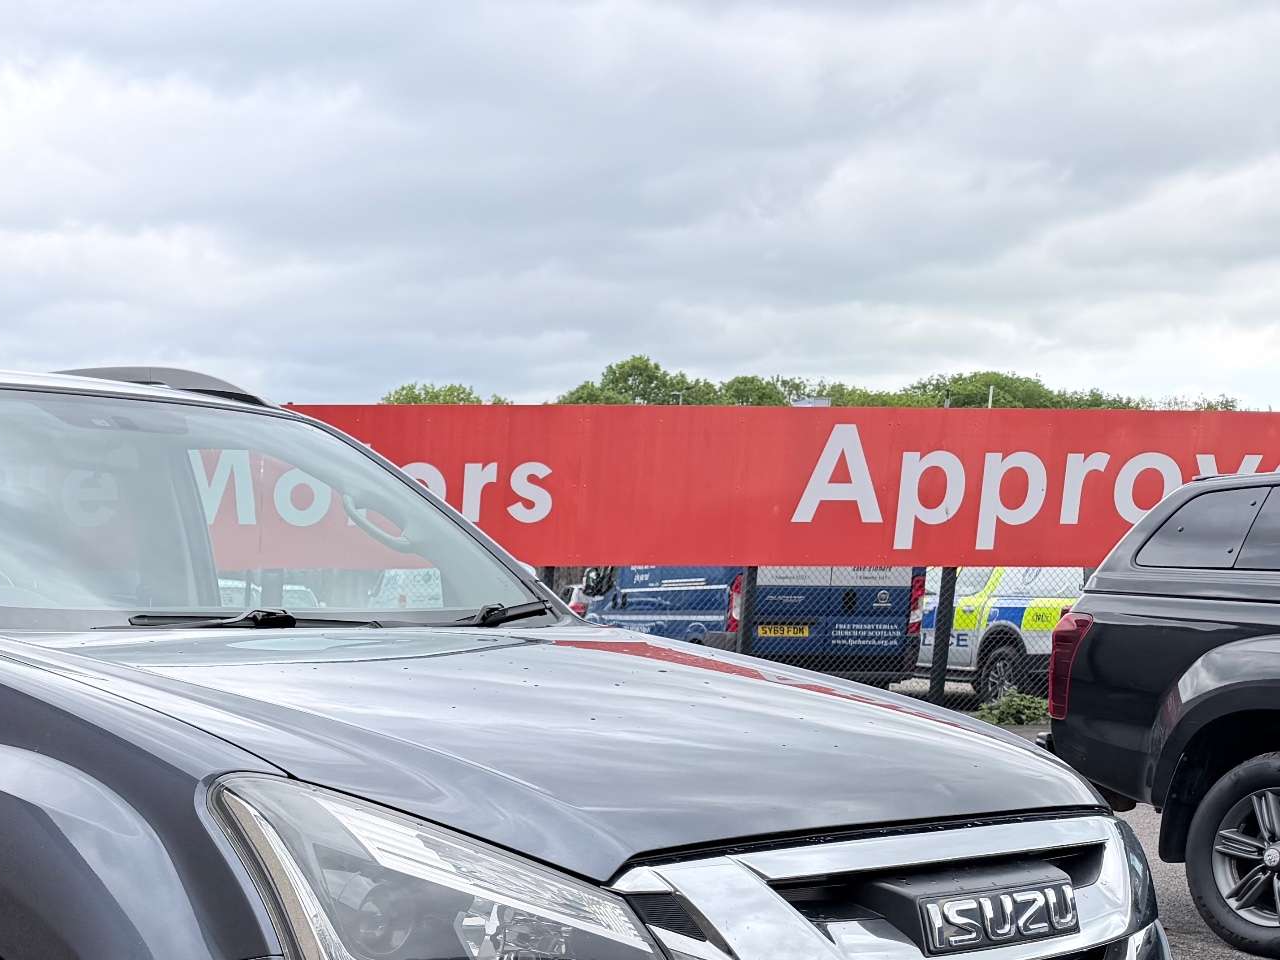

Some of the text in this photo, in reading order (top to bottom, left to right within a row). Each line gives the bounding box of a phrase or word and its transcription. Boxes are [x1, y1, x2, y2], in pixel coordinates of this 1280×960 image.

[186, 443, 553, 528] Moors
[761, 625, 785, 635] SY69
[926, 884, 1078, 948] ISUZU
